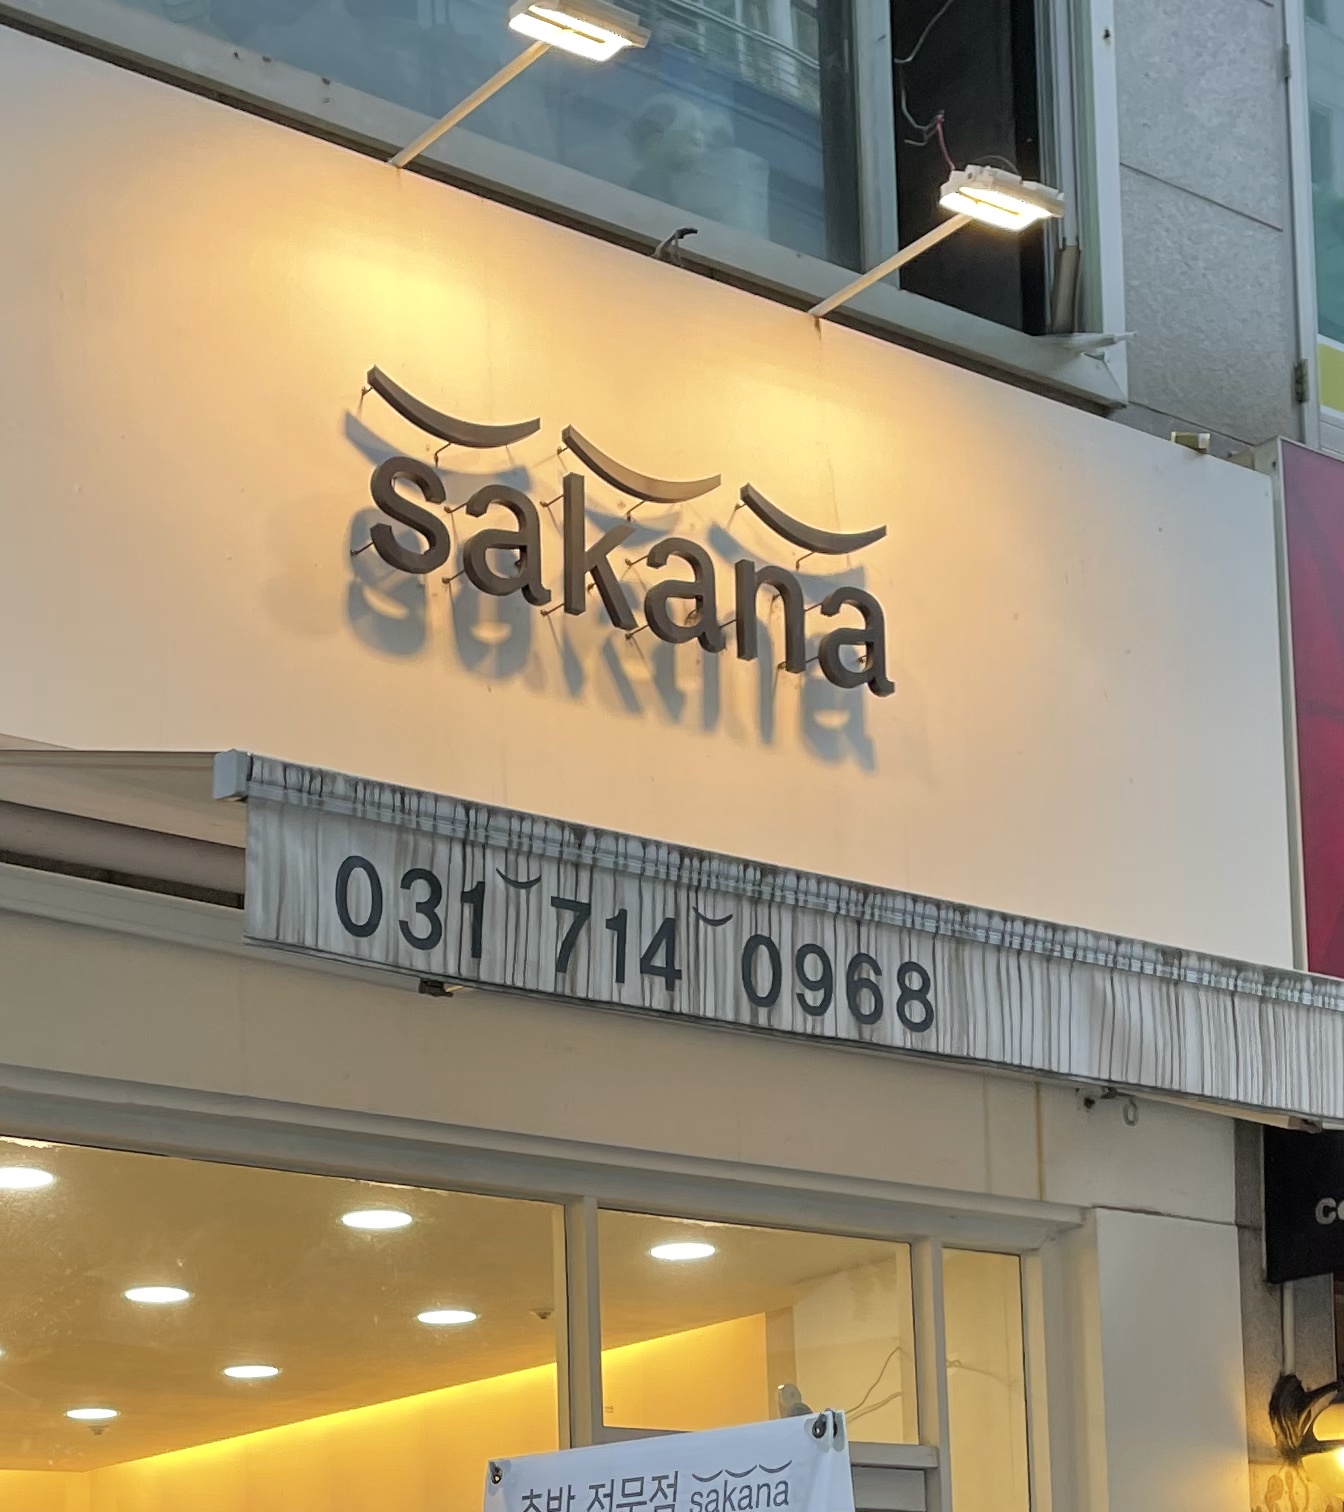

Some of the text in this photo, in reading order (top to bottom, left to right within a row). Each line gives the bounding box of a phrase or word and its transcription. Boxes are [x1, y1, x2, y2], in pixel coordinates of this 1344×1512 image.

[371, 456, 895, 697] sakana
[335, 855, 935, 1032] 031 714 0968
